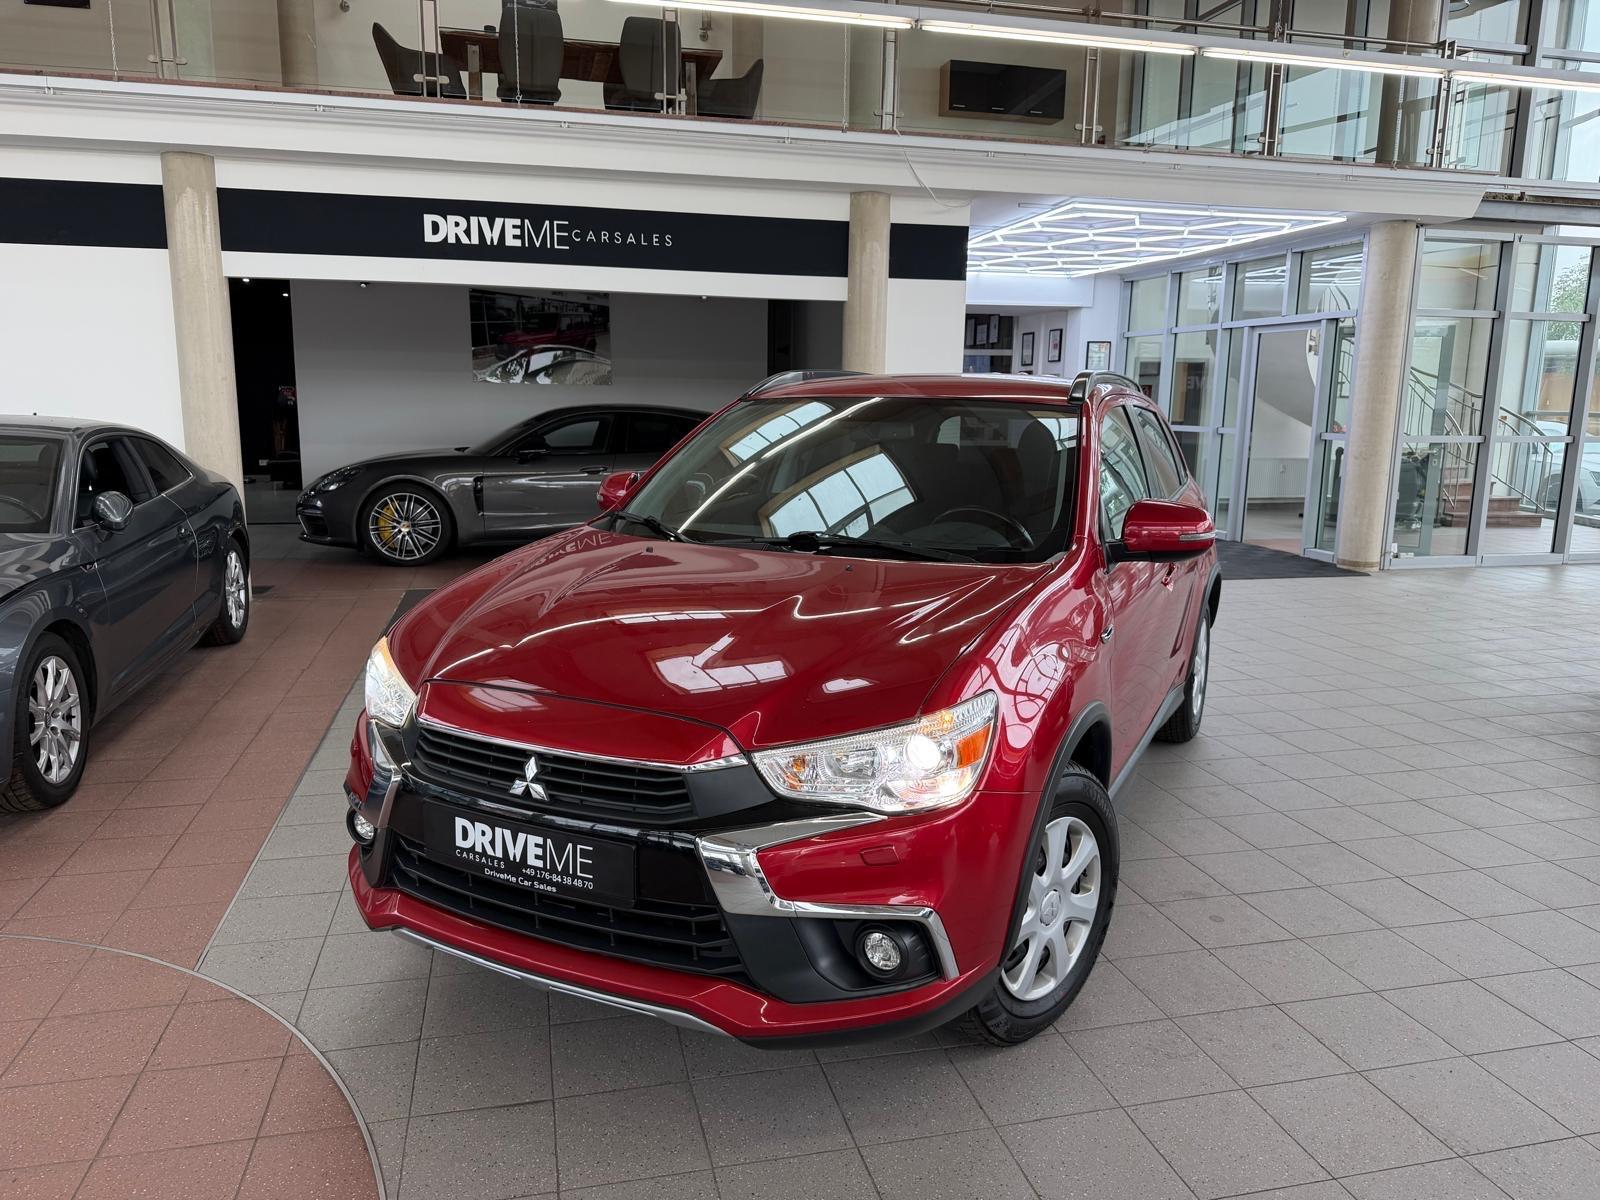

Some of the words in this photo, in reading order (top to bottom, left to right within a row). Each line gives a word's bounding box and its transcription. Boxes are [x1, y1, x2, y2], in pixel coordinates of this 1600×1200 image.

[423, 213, 570, 249] DRIVEME
[571, 229, 673, 248] CARSALES
[455, 816, 594, 879] DRIVEME
[455, 849, 506, 869] CARSALES
[484, 867, 517, 883] DriveMe
[518, 876, 532, 888] Car
[534, 881, 557, 893] Sales
[521, 867, 535, 876] +49
